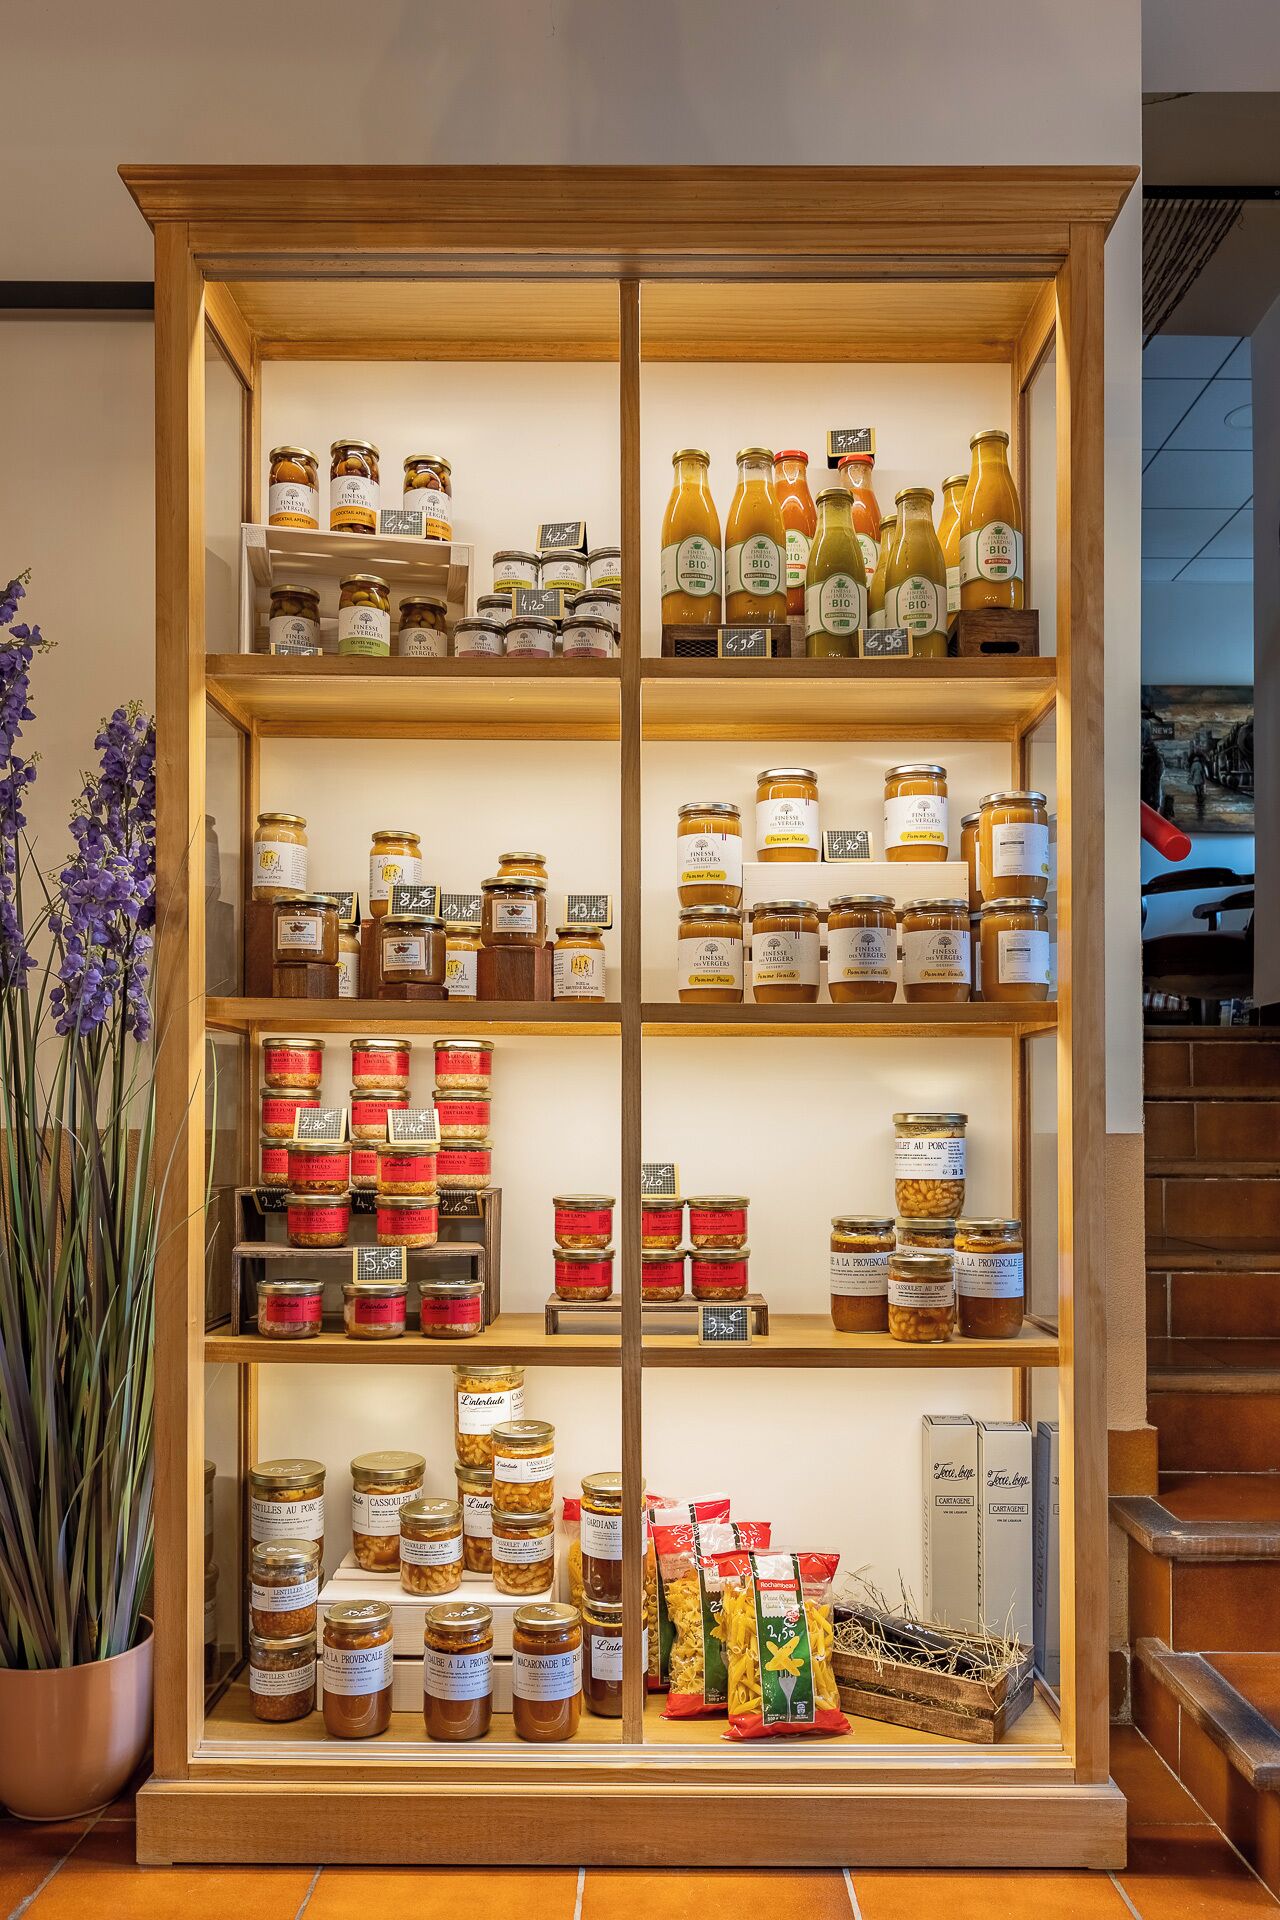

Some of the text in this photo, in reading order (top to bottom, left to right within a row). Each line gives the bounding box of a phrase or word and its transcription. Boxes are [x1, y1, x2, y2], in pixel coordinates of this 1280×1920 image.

[989, 546, 1008, 554] BIO
[688, 560, 707, 569] BIO
[752, 559, 770, 569] BIO
[832, 599, 851, 608] BIO
[908, 600, 927, 610] BIO
[353, 624, 379, 632] FINESSE
[285, 633, 311, 642] FINESSE
[356, 629, 384, 639] VERGERS
[1152, 727, 1173, 735] NEWS
[693, 855, 721, 863] VERGERS
[685, 872, 705, 880] Pomme
[765, 955, 794, 963] VERGERS
[857, 951, 887, 959] VERGERS
[935, 953, 963, 961] VERGERS
[757, 971, 796, 980] Pomme Vanille
[846, 968, 869, 976] Pomme
[694, 976, 714, 984] Pomme
[914, 1141, 924, 1150] AU
[928, 1141, 948, 1150] PORC
[842, 1259, 851, 1267] LA
[967, 1259, 976, 1267] LA
[895, 1284, 923, 1292] CASSOULET
[460, 1394, 505, 1406] L'interlude
[286, 1503, 318, 1514] AU PORC
[586, 1516, 618, 1530] GARDIANE
[496, 1539, 521, 1549] CASSOULET
[760, 1581, 796, 1589] Rochambeau
[273, 1585, 303, 1596] LENTILLES
[595, 1639, 622, 1651] L'inte
[330, 1655, 338, 1663] LA
[341, 1651, 383, 1664] PROVENCALE
[427, 1656, 445, 1668] DAUBE
[447, 1658, 453, 1668] A
[456, 1658, 466, 1668] LA
[517, 1656, 570, 1669] MACARONADE DE
[257, 1671, 285, 1680] LENTILLES
